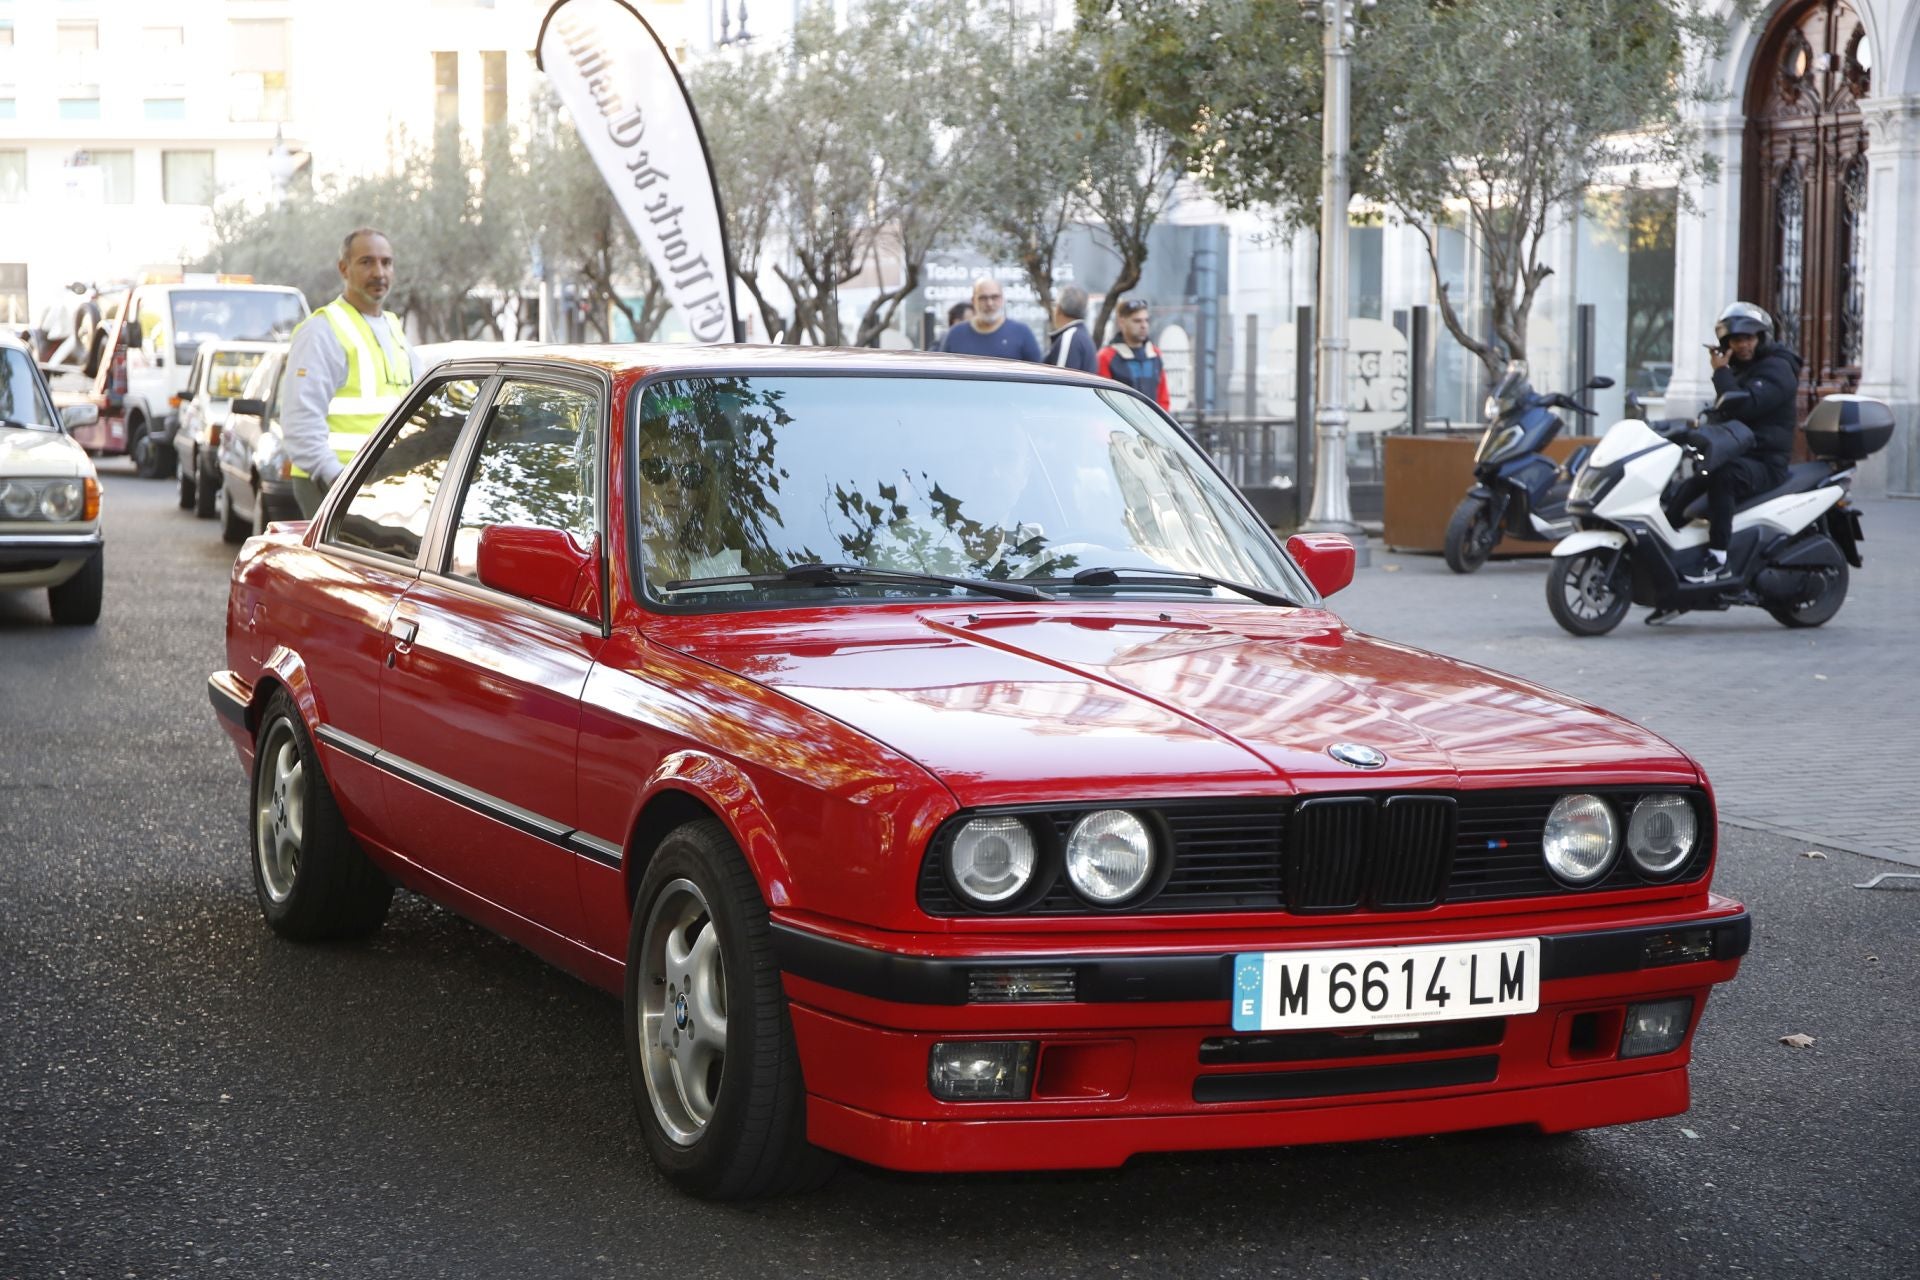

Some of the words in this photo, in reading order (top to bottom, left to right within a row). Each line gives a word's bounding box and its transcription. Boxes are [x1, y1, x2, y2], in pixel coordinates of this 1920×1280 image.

[926, 262, 969, 280] Todo
[1279, 963, 1309, 1016] M
[1328, 956, 1450, 1014] 6614
[1469, 950, 1525, 1005] LM
[1241, 999, 1254, 1015] E
